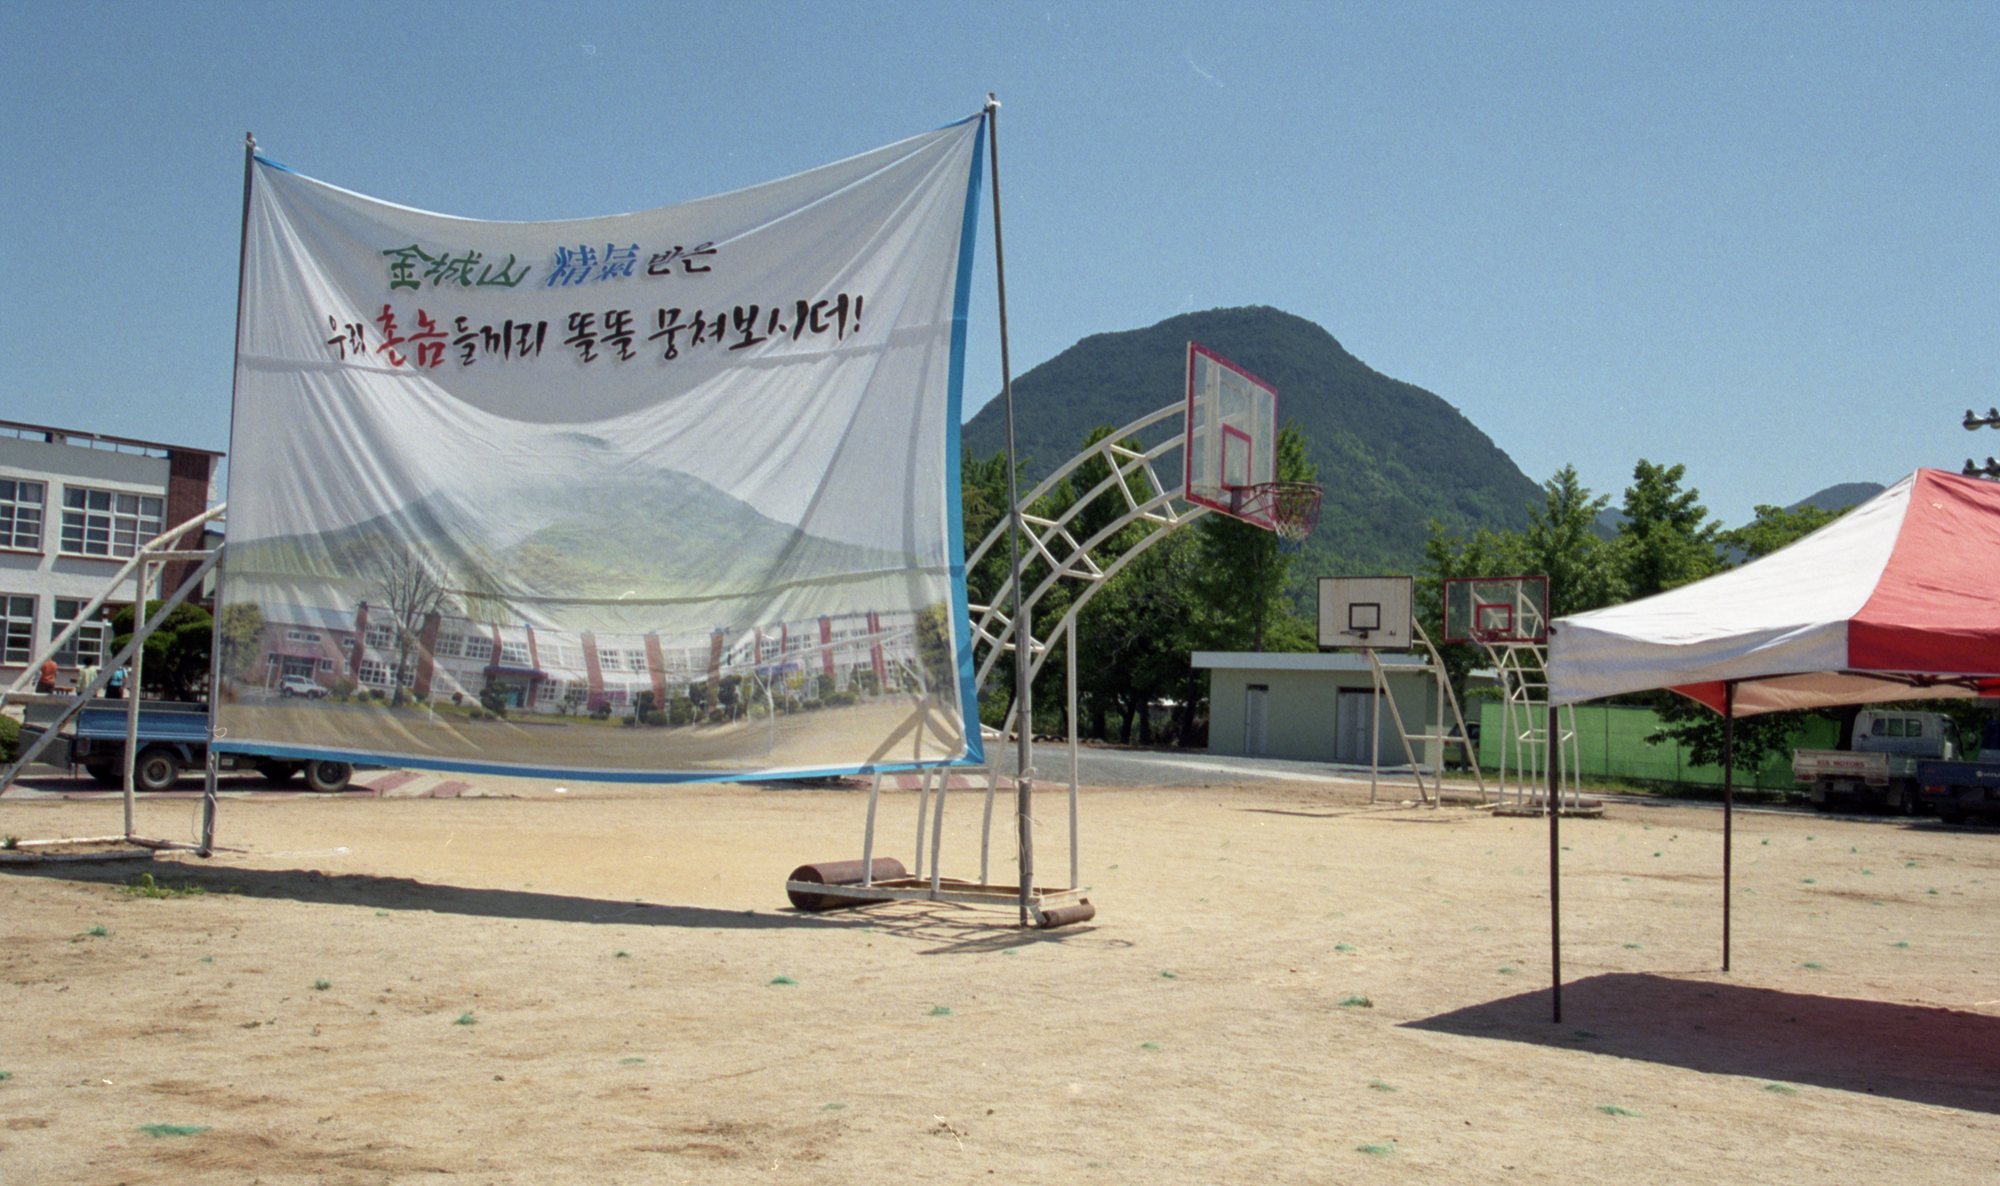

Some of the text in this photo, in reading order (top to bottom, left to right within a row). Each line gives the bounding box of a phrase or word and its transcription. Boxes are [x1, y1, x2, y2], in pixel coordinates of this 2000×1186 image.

[382, 243, 532, 291] 金城山
[646, 240, 718, 277] 받은
[326, 314, 367, 361] 우리
[563, 309, 637, 363] 똘똘
[1816, 759, 1865, 768] KIA MOTORS
